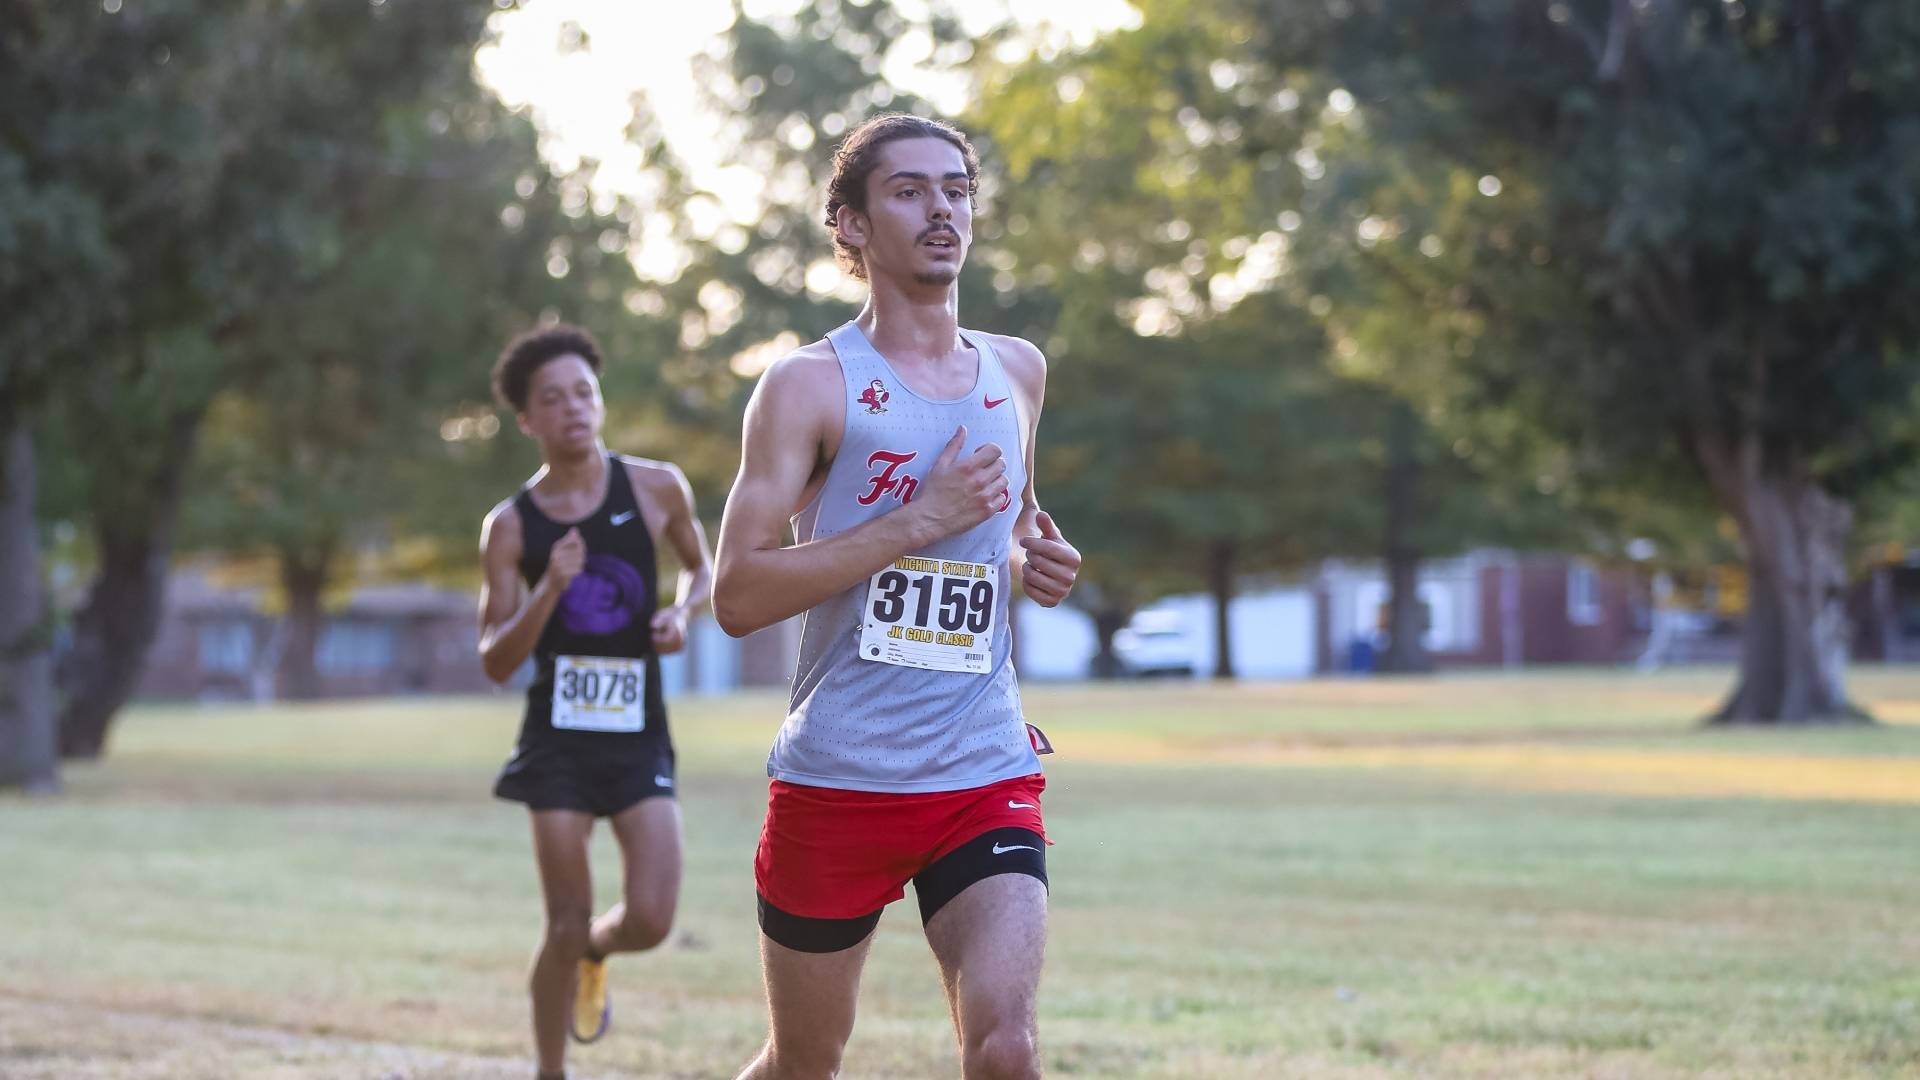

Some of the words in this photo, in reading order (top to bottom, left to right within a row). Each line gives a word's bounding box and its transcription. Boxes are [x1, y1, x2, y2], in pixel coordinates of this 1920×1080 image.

[894, 557, 939, 573] WICHITA
[942, 562, 973, 575] STATE
[873, 571, 993, 633] 3159
[887, 625, 904, 639] JK
[905, 628, 933, 643] GOLD
[936, 632, 974, 647] CLASSIC
[562, 669, 637, 704] 3078
